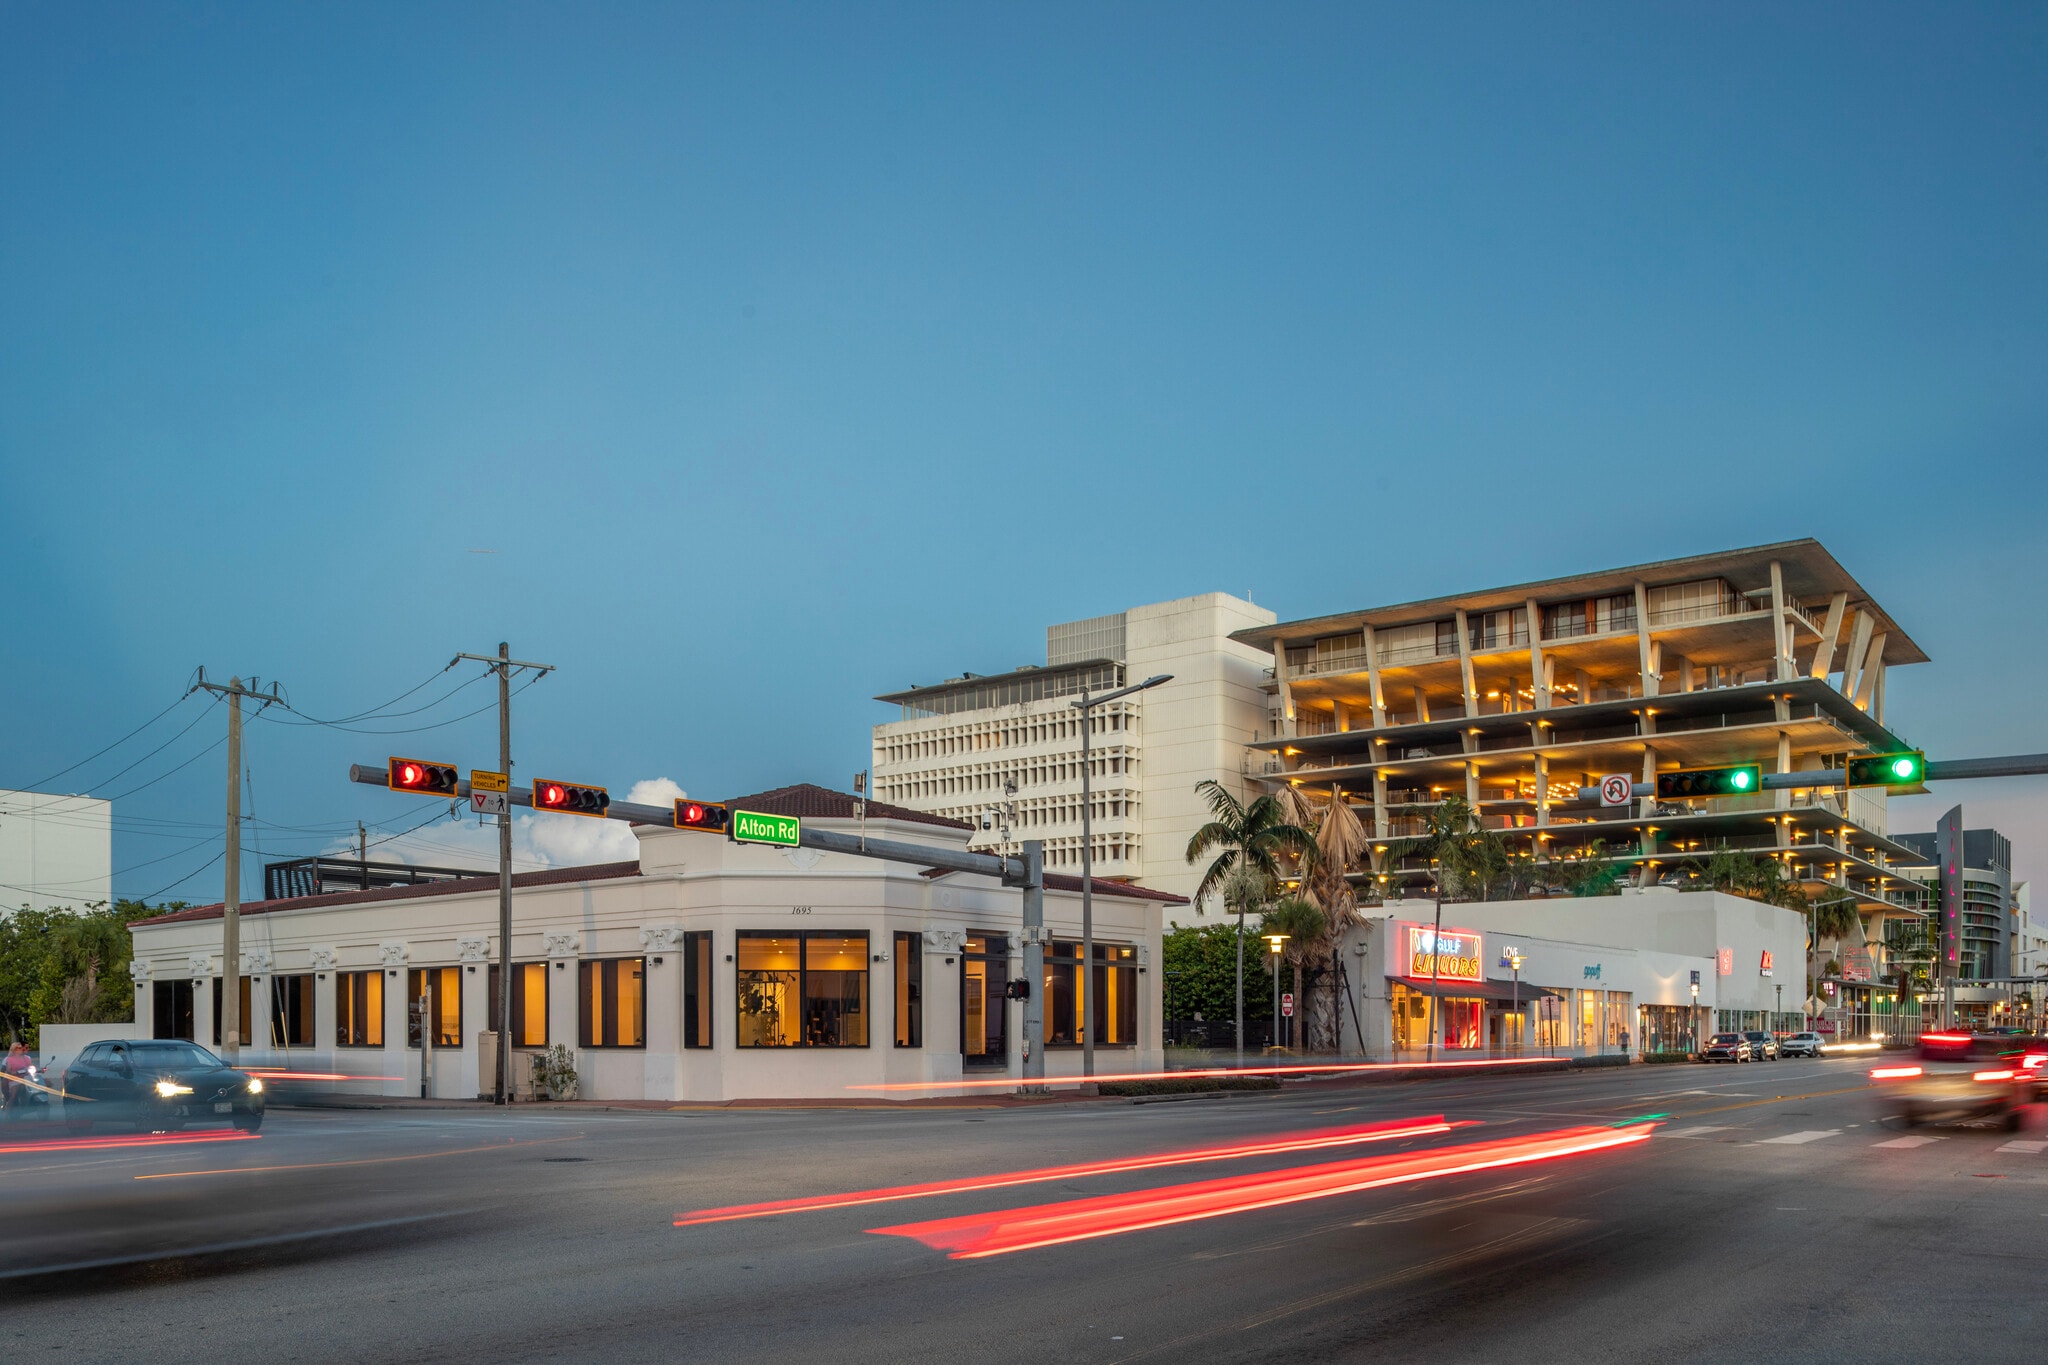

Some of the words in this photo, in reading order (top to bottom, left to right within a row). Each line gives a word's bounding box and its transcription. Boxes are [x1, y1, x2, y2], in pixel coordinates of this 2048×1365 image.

[474, 773, 496, 781] TURNING
[739, 818, 774, 838] Alton
[779, 822, 795, 839] Rd
[792, 906, 811, 914] 1695
[1437, 936, 1461, 953] GULF
